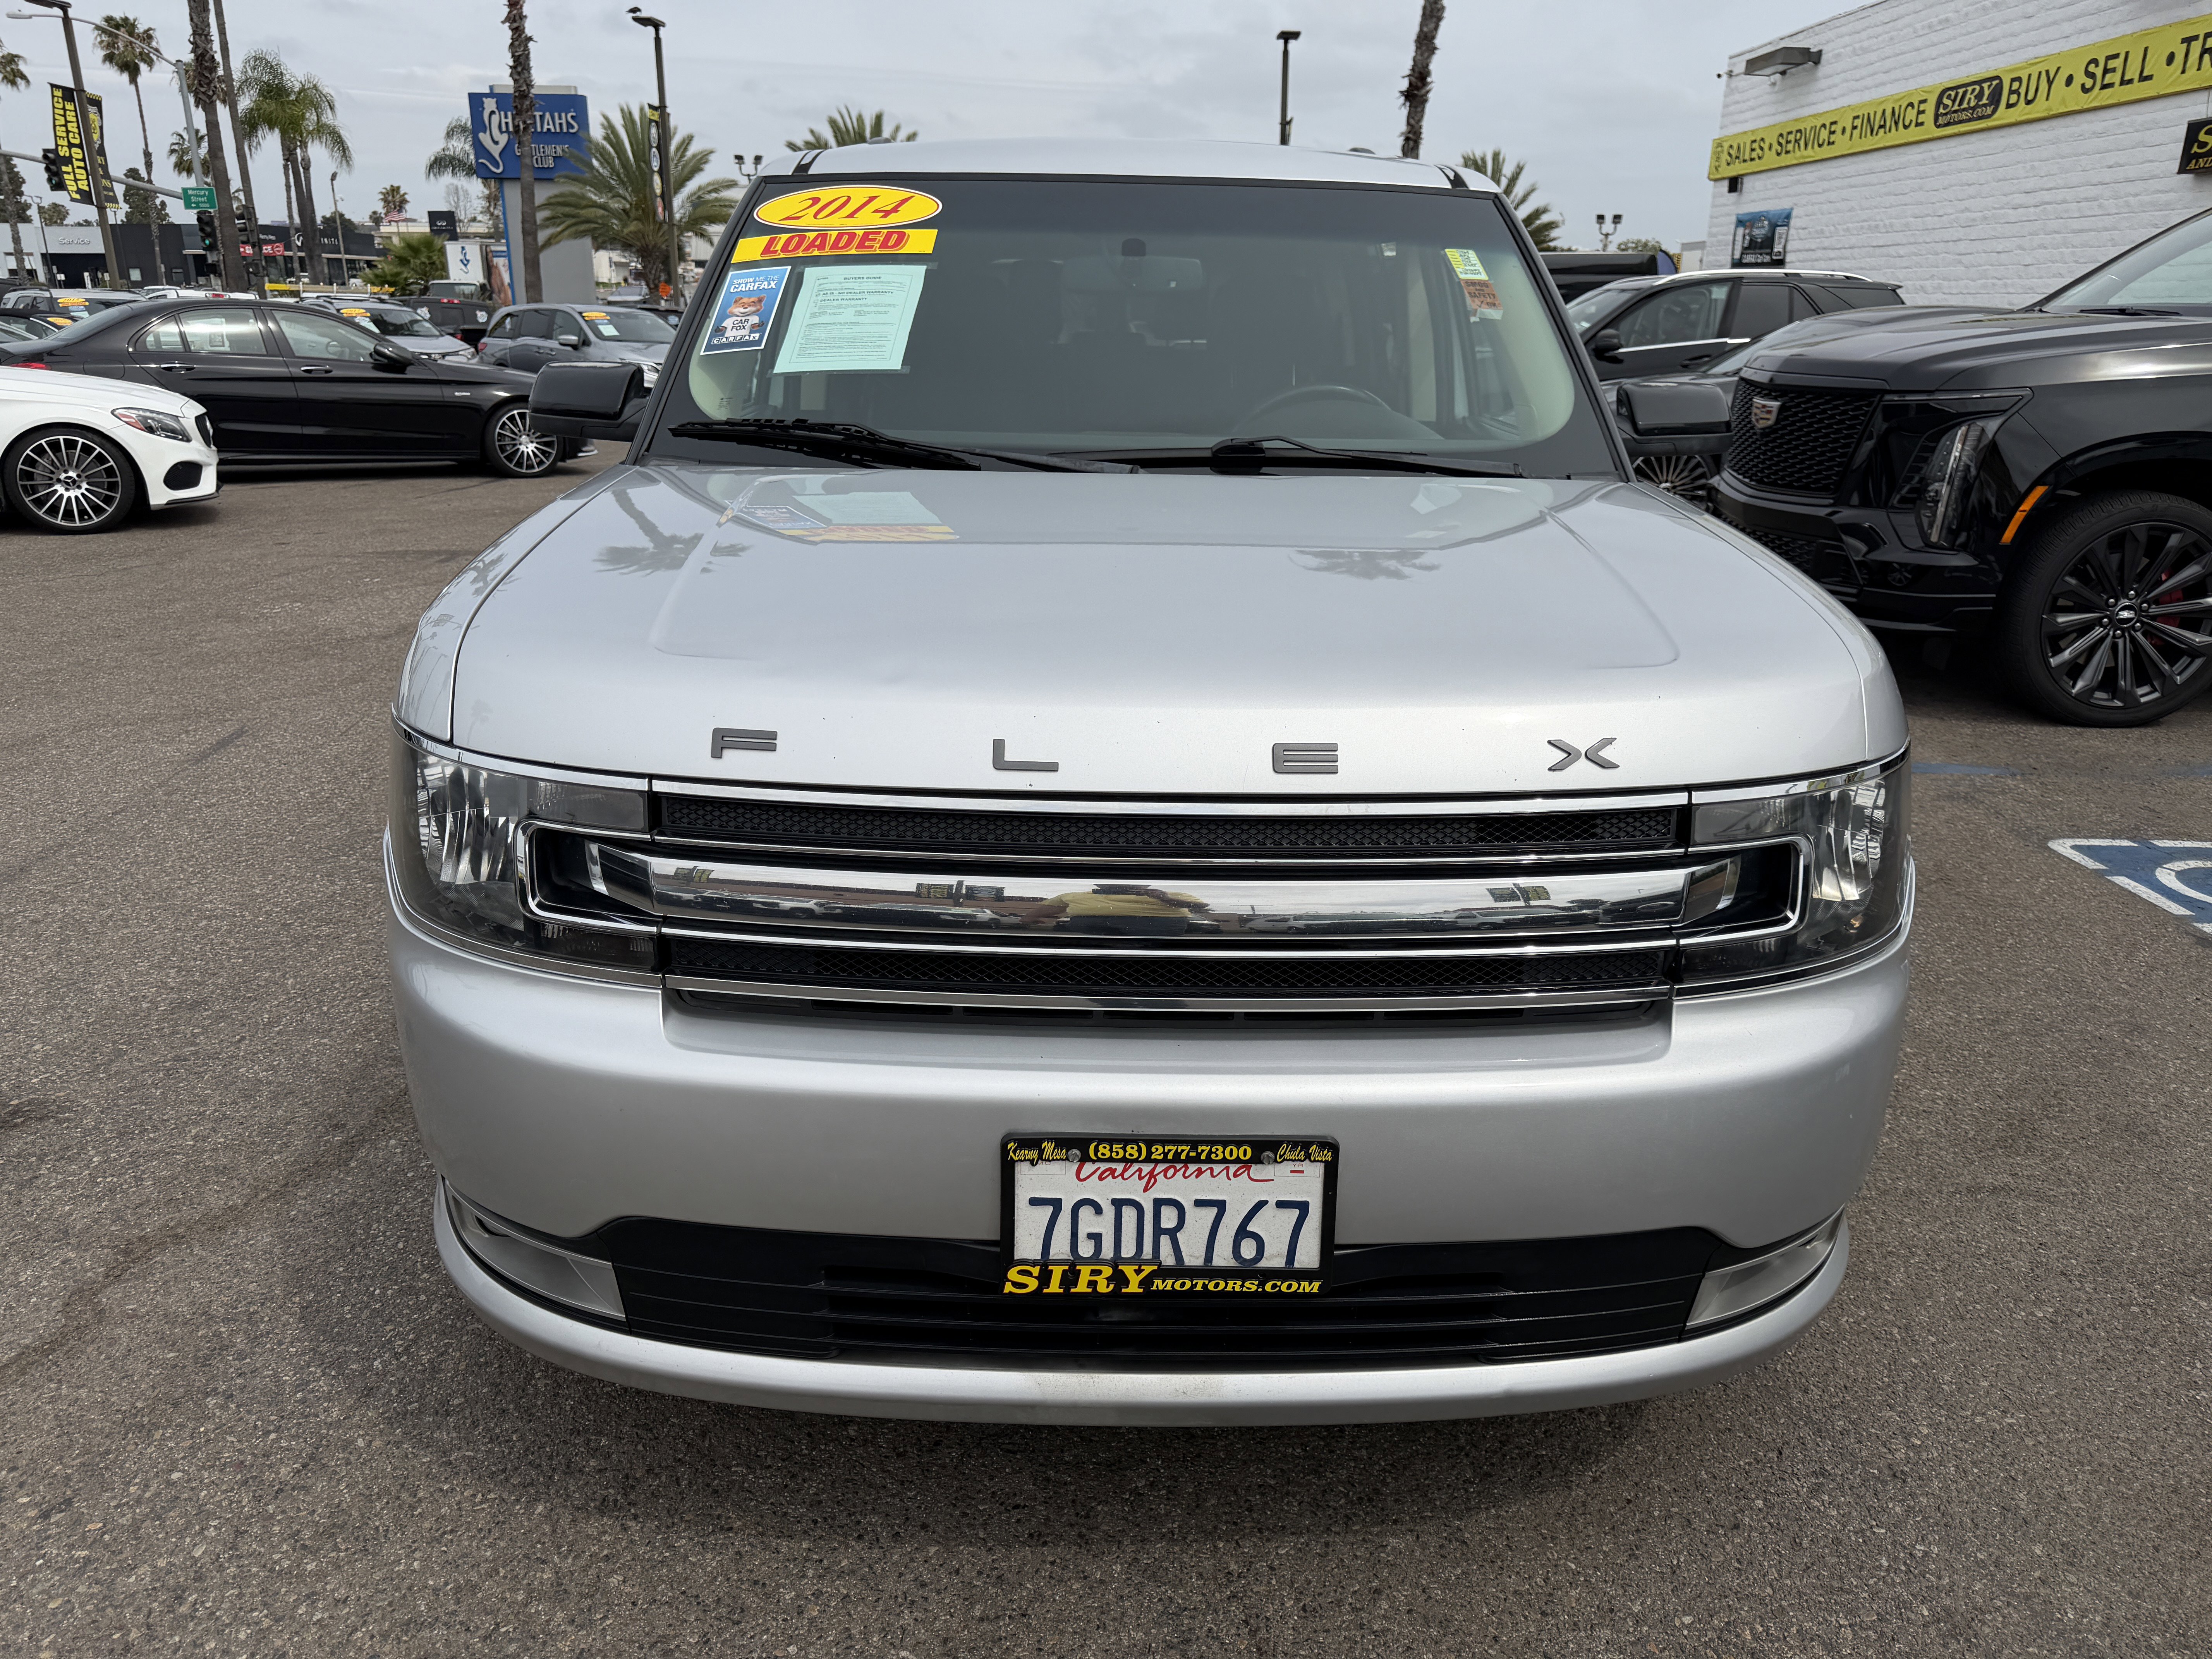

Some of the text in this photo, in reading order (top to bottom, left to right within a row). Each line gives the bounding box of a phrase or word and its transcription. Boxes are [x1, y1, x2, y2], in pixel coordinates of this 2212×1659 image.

[2005, 66, 2061, 110] BUY
[2080, 46, 2154, 94] SELL
[1938, 80, 2000, 114] SIRY
[1937, 105, 1995, 125] MOTORS.COM
[53, 88, 81, 199] FULL SERVICE
[1725, 137, 1765, 167] SALES
[1775, 120, 1838, 157] SERVICE
[1849, 98, 1928, 141] FINANCE
[65, 101, 89, 191] AUTO CARE
[515, 144, 569, 156] GTLEMEN'S
[533, 156, 554, 167] CLUB
[778, 195, 915, 221] 2014
[761, 230, 910, 257] LOADED
[730, 281, 778, 293] CARFAX
[711, 333, 760, 344] CARFAX
[1008, 1141, 1066, 1164] Kearny Mesa
[1089, 1142, 1252, 1161] (858) 277-7300
[1277, 1144, 1332, 1162] Chula Vista
[1075, 1162, 1274, 1193] California
[1028, 1197, 1310, 1267] 7GDR767
[1004, 1264, 1322, 1293] SIRY MOTORS.COM
